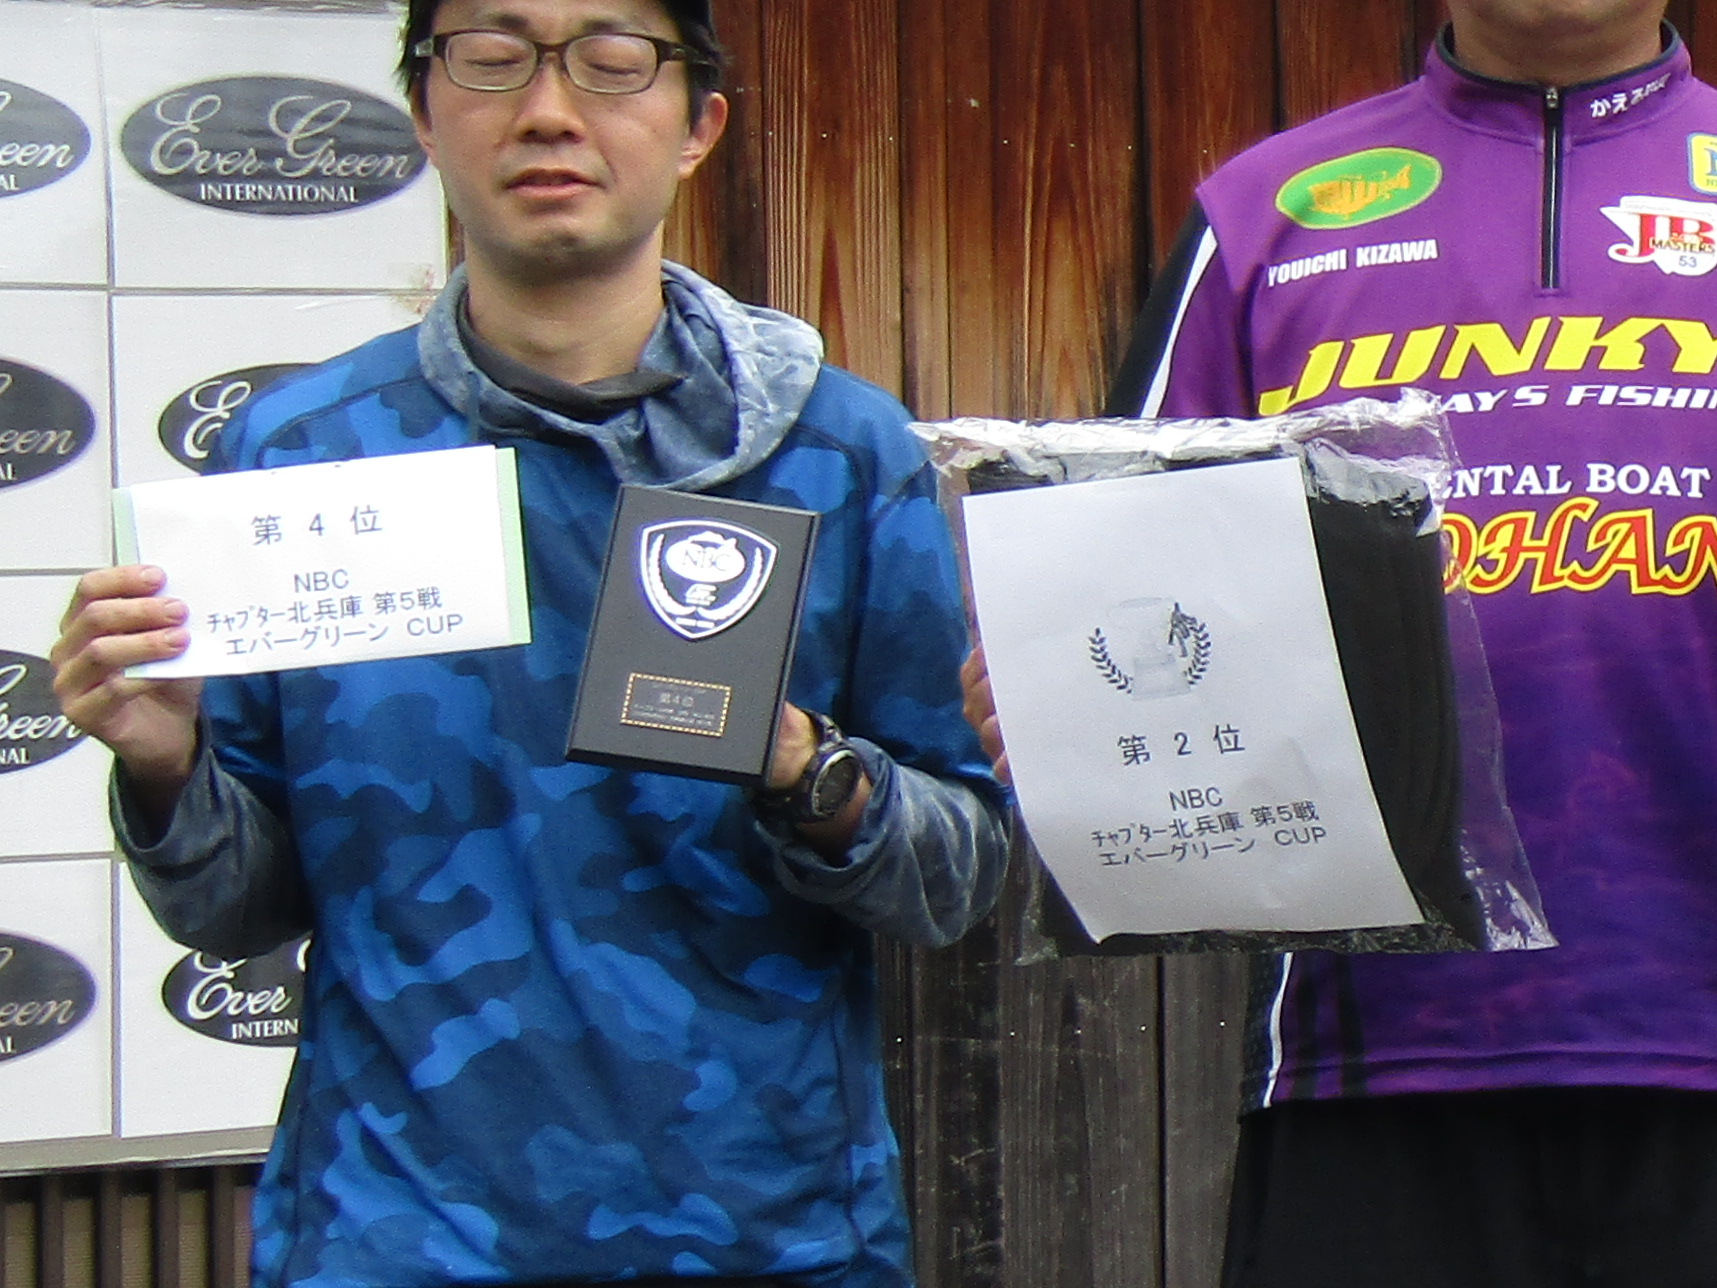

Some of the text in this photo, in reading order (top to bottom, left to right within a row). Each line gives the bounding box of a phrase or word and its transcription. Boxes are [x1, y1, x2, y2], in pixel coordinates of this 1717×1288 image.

[150, 93, 412, 179] Ever Green
[200, 182, 360, 204] INTERNATIONAL
[1651, 238, 1716, 254] MASTERS
[1267, 239, 1439, 287] YOUICHI KIZAWA
[1678, 255, 1698, 268] 53
[1585, 462, 1712, 499] BOAT
[293, 568, 350, 593] NBC
[373, 586, 443, 616] 第5戦
[225, 613, 464, 656] エバーグリーン CUP
[1168, 786, 1223, 811] NBC
[1250, 800, 1320, 827] 第5戦
[1099, 826, 1327, 866] エバーグリーン CUP
[231, 1019, 299, 1040] INTERN
